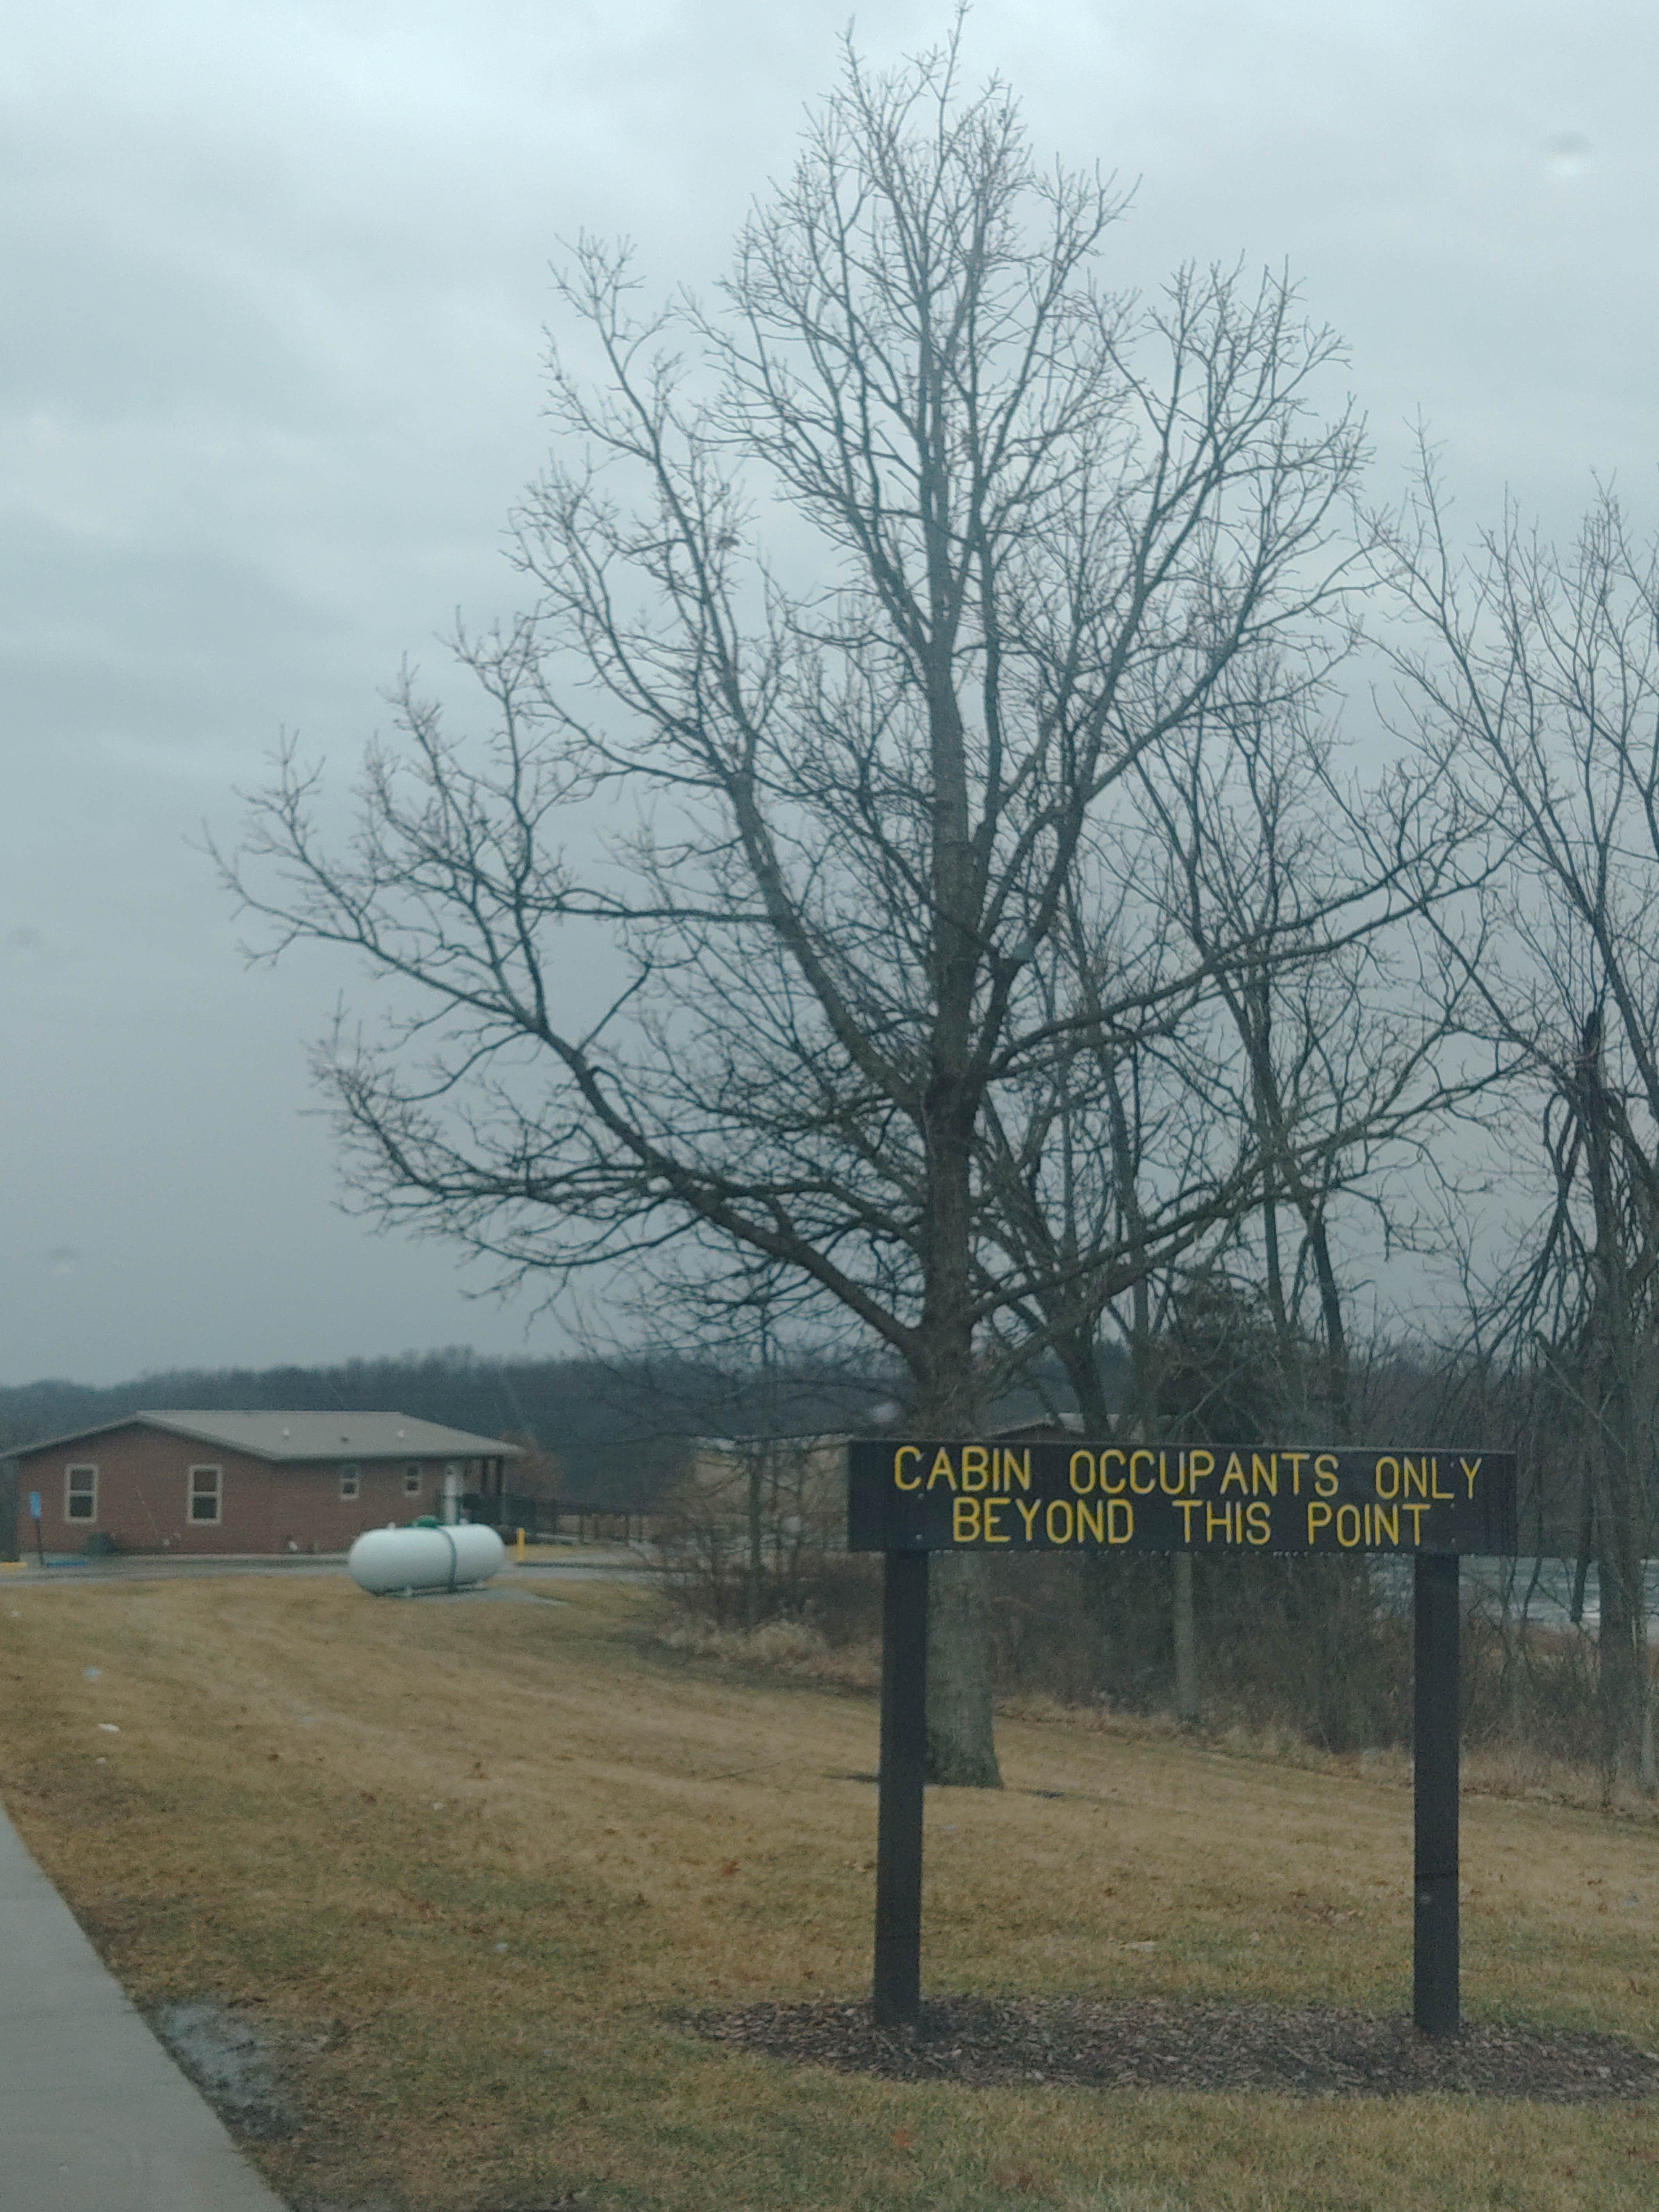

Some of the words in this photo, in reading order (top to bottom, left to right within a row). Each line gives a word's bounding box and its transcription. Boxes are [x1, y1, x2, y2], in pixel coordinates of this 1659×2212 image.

[894, 1445, 1031, 1491] CABIN
[1069, 1449, 1339, 1497] OCCUPANTS
[1375, 1456, 1482, 1499] ONLY
[953, 1496, 1134, 1544] BEYOND
[1173, 1499, 1271, 1545] THIS
[1308, 1501, 1431, 1547] POINT
